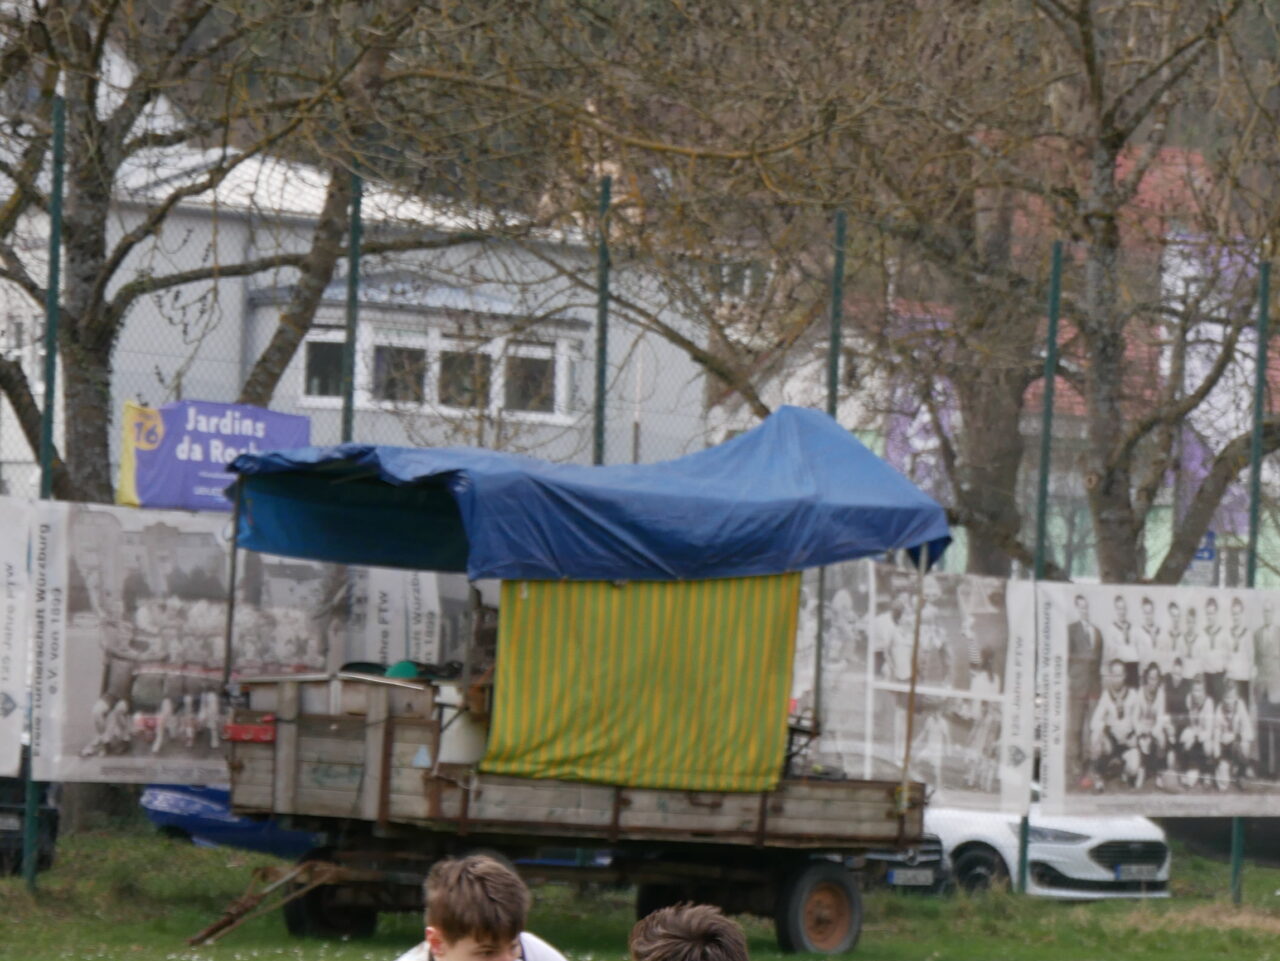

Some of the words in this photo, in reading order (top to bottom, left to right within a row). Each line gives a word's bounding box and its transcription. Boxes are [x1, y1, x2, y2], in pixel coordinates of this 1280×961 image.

[133, 421, 160, 444] 16
[185, 406, 266, 438] Jardins
[175, 435, 204, 462] da
[35, 522, 50, 603] Würzburg
[378, 591, 391, 625] FTW
